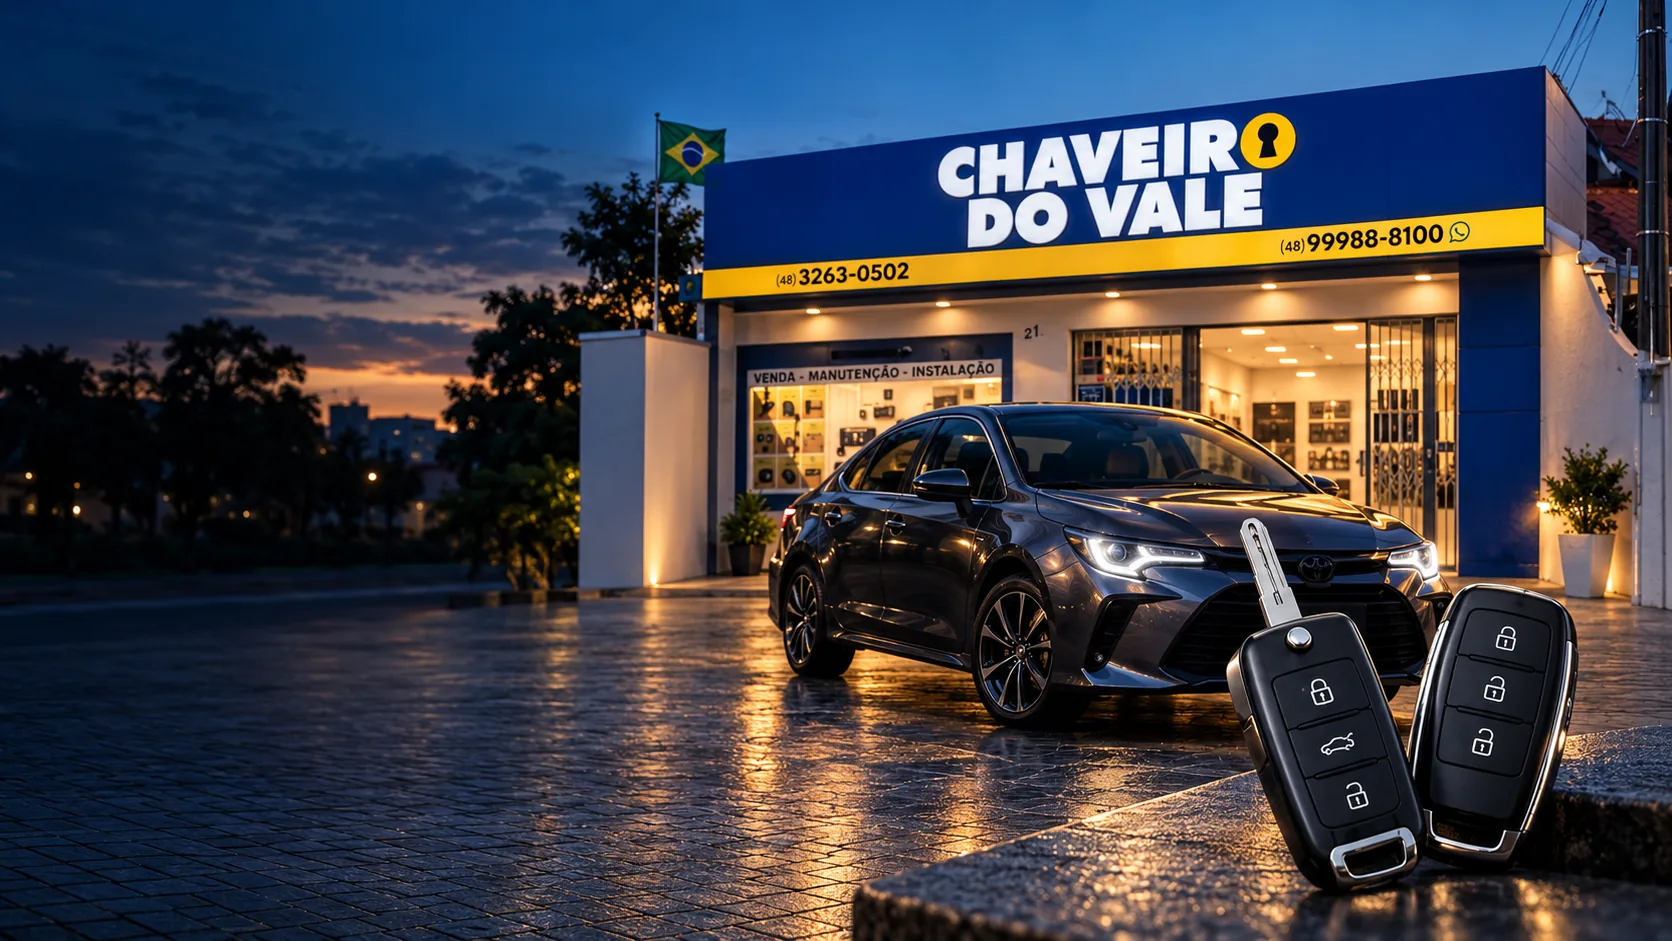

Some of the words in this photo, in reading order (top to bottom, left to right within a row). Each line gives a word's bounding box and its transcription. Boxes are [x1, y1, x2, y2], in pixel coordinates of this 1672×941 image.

[938, 112, 1297, 198] CHAVEIRO
[967, 191, 1069, 249] DO
[1085, 171, 1264, 239] VALE
[1307, 224, 1444, 252] 99988-8100
[799, 262, 909, 285] 3263-0502
[754, 371, 796, 384] VENDA
[808, 365, 900, 382] MANUTENÇÃO
[912, 361, 995, 379] INSTALAÇÃO
